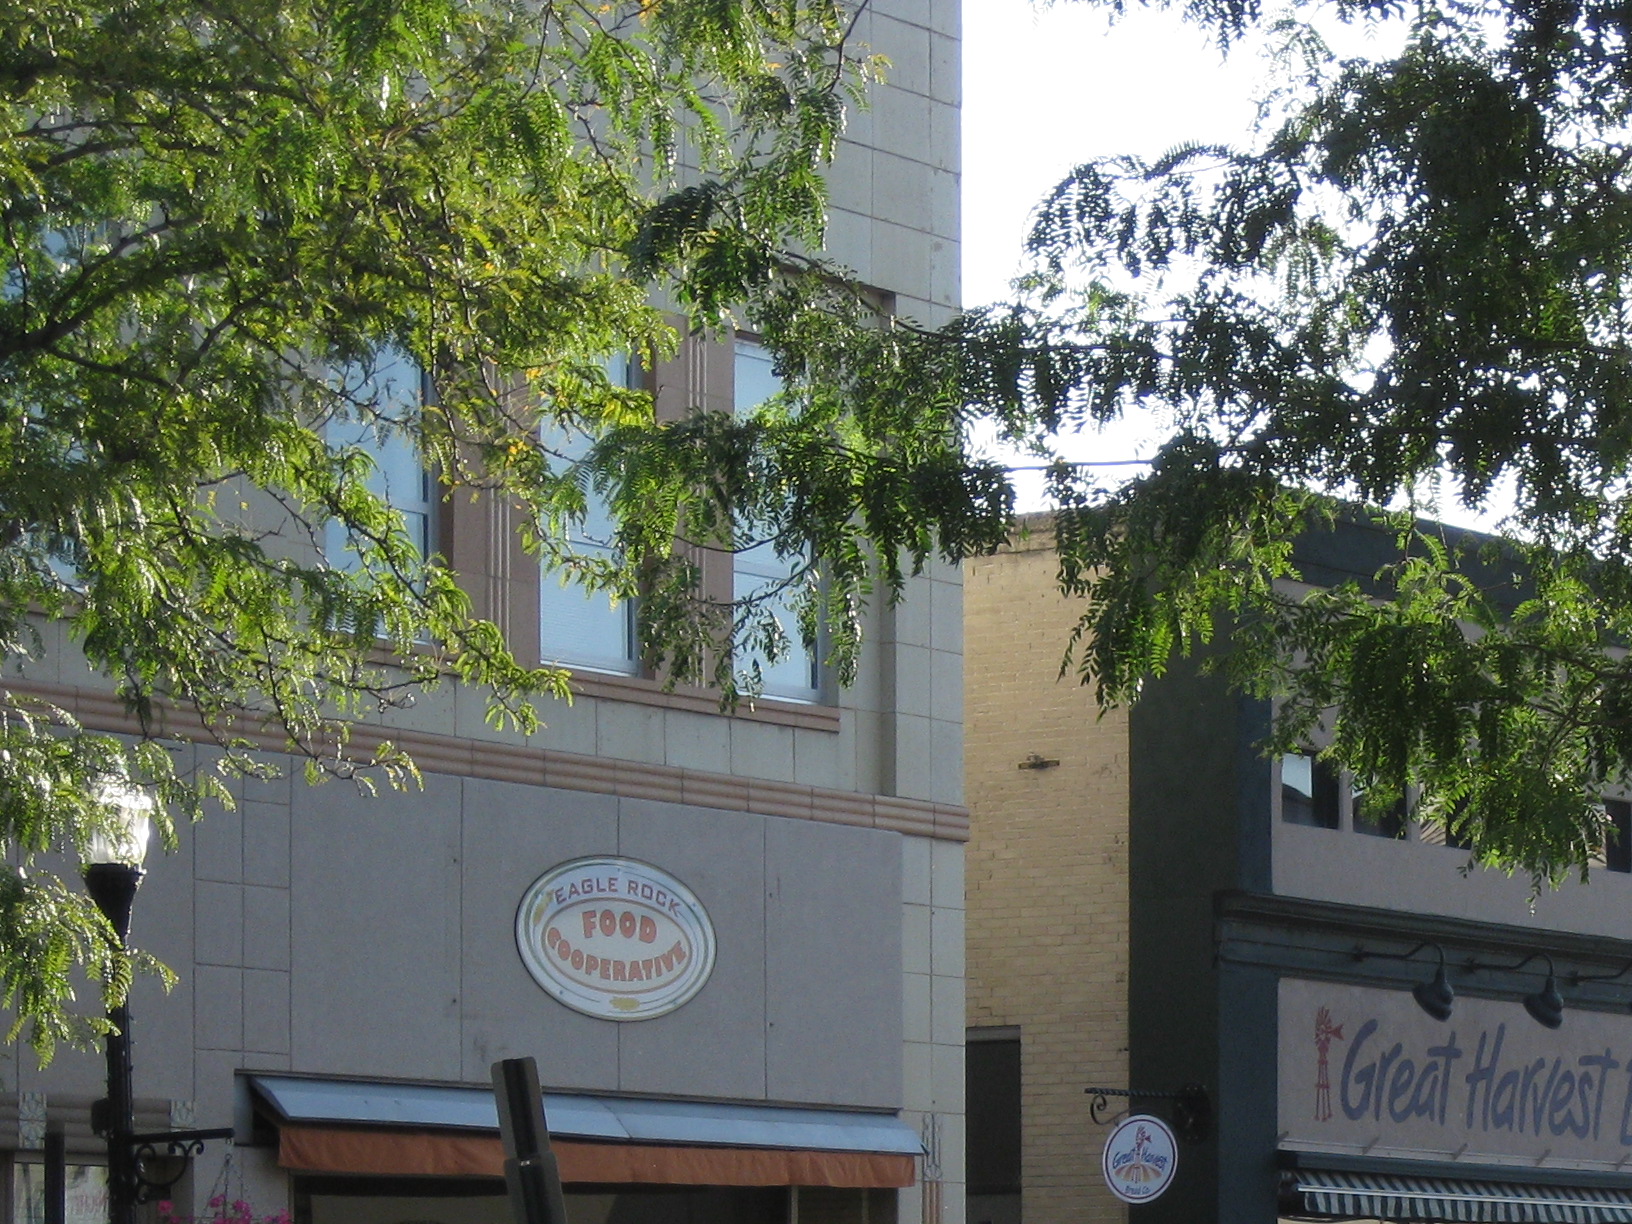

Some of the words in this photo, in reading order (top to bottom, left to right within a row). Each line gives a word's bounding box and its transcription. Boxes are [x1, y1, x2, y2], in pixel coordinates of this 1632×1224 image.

[554, 877, 619, 905] EAGLE
[627, 880, 682, 918] ROCK
[582, 909, 658, 944] FOOD
[547, 927, 688, 982] COOPERATIVE
[1340, 1018, 1463, 1127] Great
[1465, 1023, 1620, 1141] Harvest
